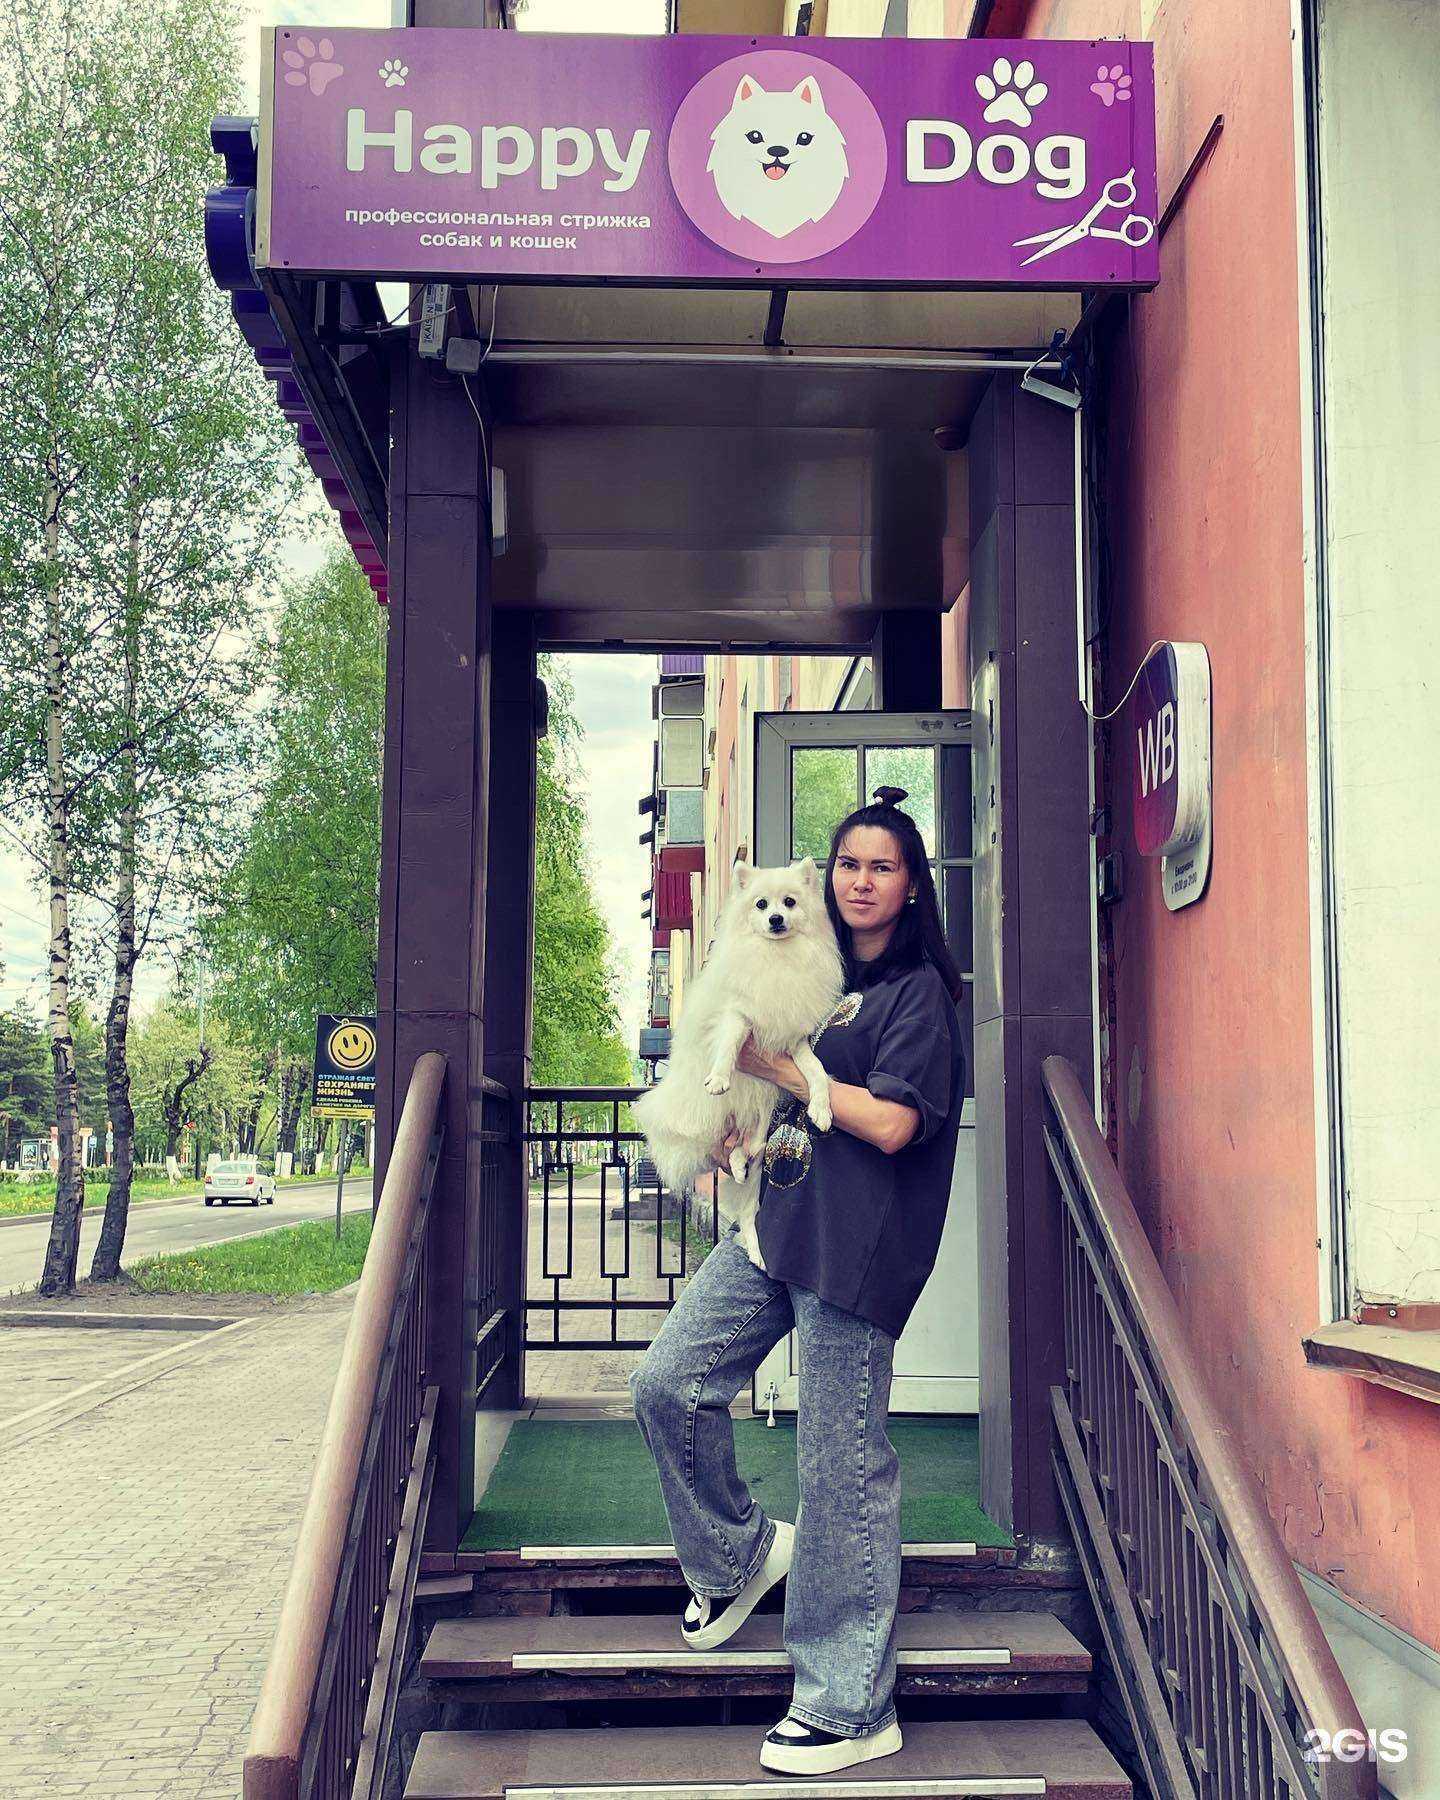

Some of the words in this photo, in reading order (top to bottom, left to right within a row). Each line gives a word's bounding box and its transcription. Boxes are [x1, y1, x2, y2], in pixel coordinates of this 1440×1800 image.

[346, 108, 651, 193] Happy
[906, 119, 1086, 200] Dog
[345, 208, 553, 226] профессиональная
[560, 212, 651, 229] стрижка
[419, 231, 483, 248] собак
[490, 234, 503, 247] и
[510, 234, 577, 249] кошек
[1137, 701, 1176, 798] WB
[316, 1088, 354, 1096] ЖИЗНЬ
[318, 1080, 376, 1090] СОХРАНЯЕТ
